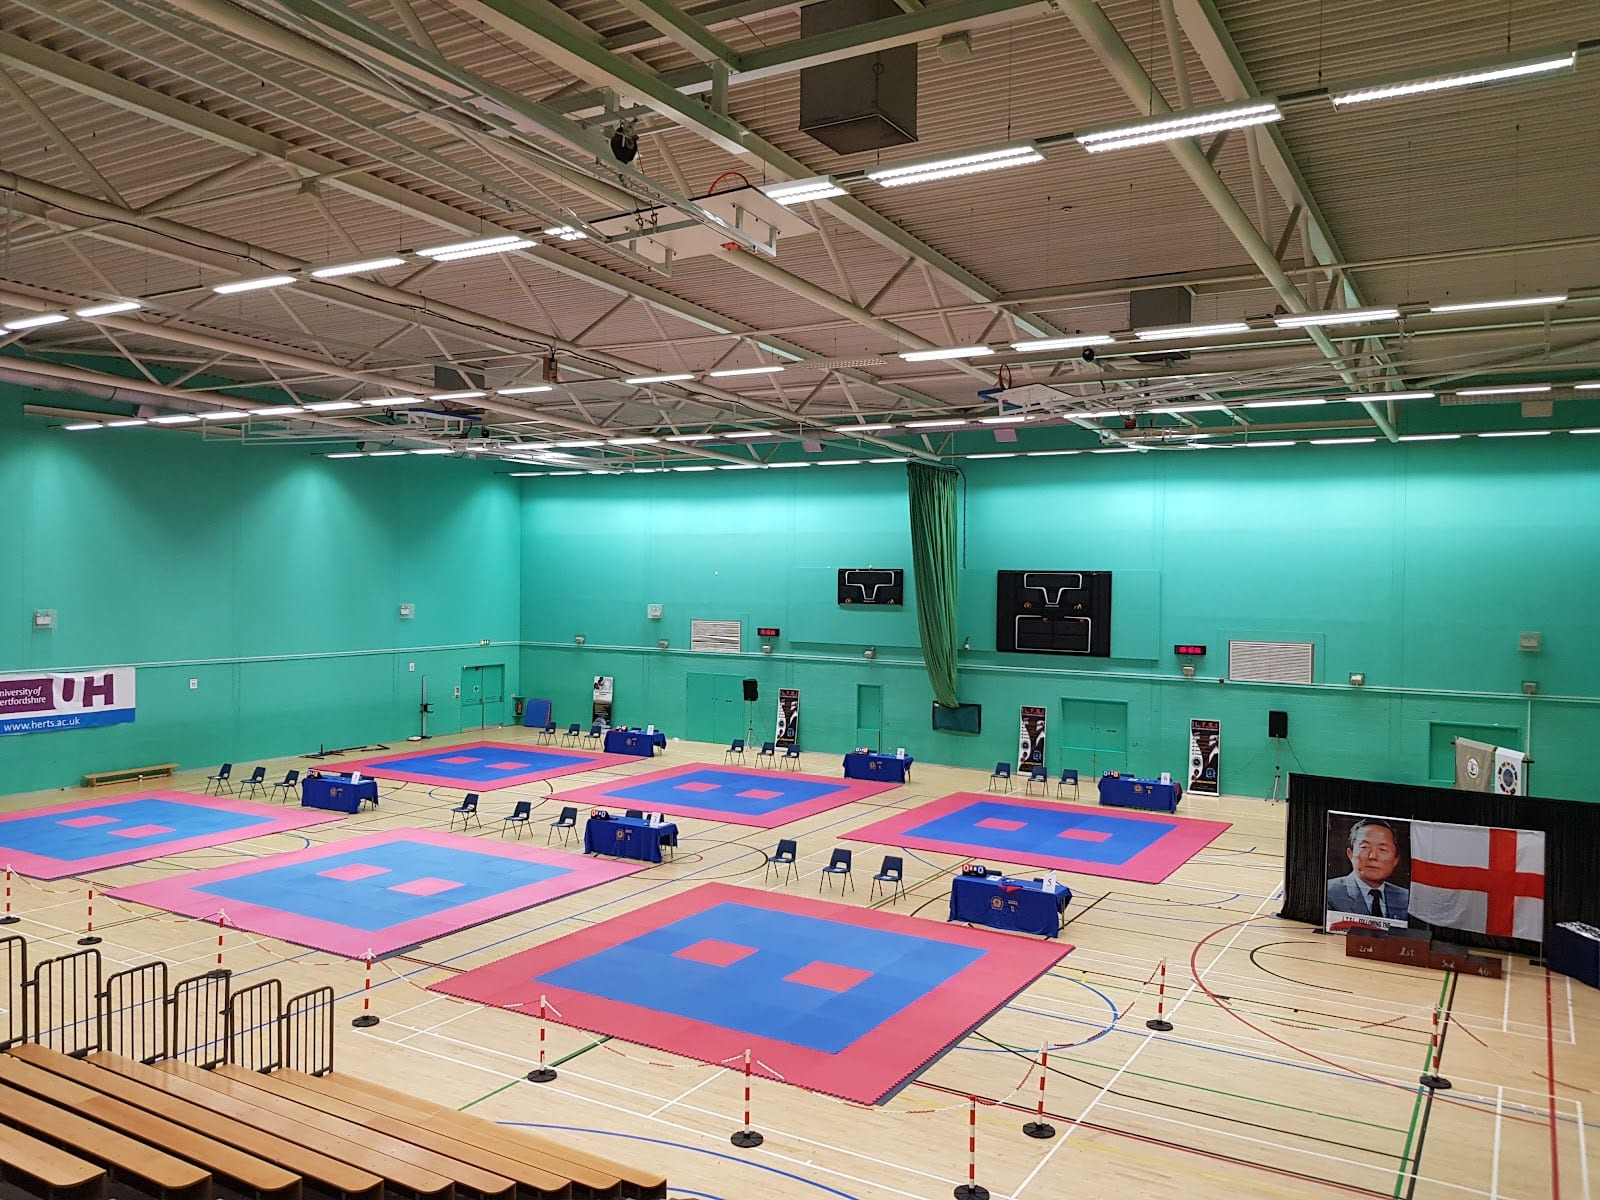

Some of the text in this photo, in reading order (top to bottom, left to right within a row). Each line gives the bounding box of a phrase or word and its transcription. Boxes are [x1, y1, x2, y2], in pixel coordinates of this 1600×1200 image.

[33, 686, 42, 696] of
[62, 674, 114, 708] UH
[4, 717, 80, 731] www.herts.ac.uk
